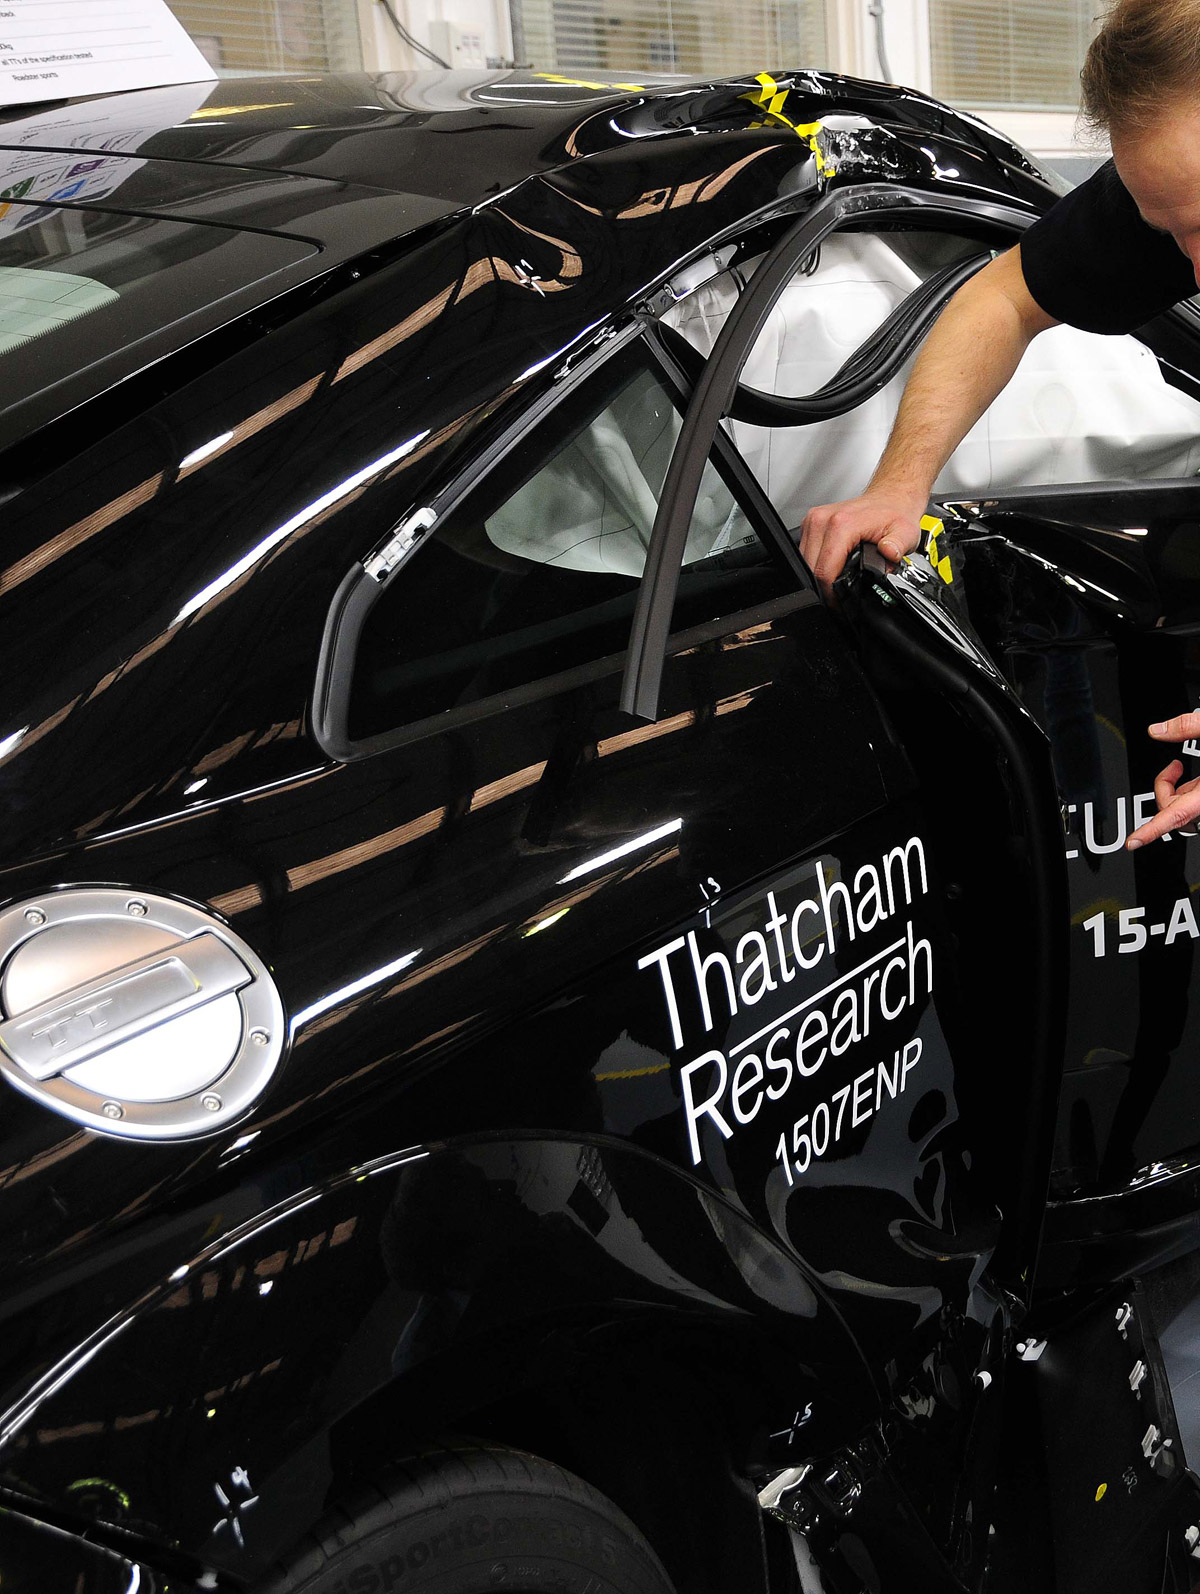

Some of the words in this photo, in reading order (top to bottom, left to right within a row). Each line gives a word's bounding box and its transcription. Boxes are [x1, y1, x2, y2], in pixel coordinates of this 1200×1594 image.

[638, 837, 928, 1050] Thatcham
[680, 921, 932, 1165] Research
[775, 1037, 922, 1187] 1507ENP
